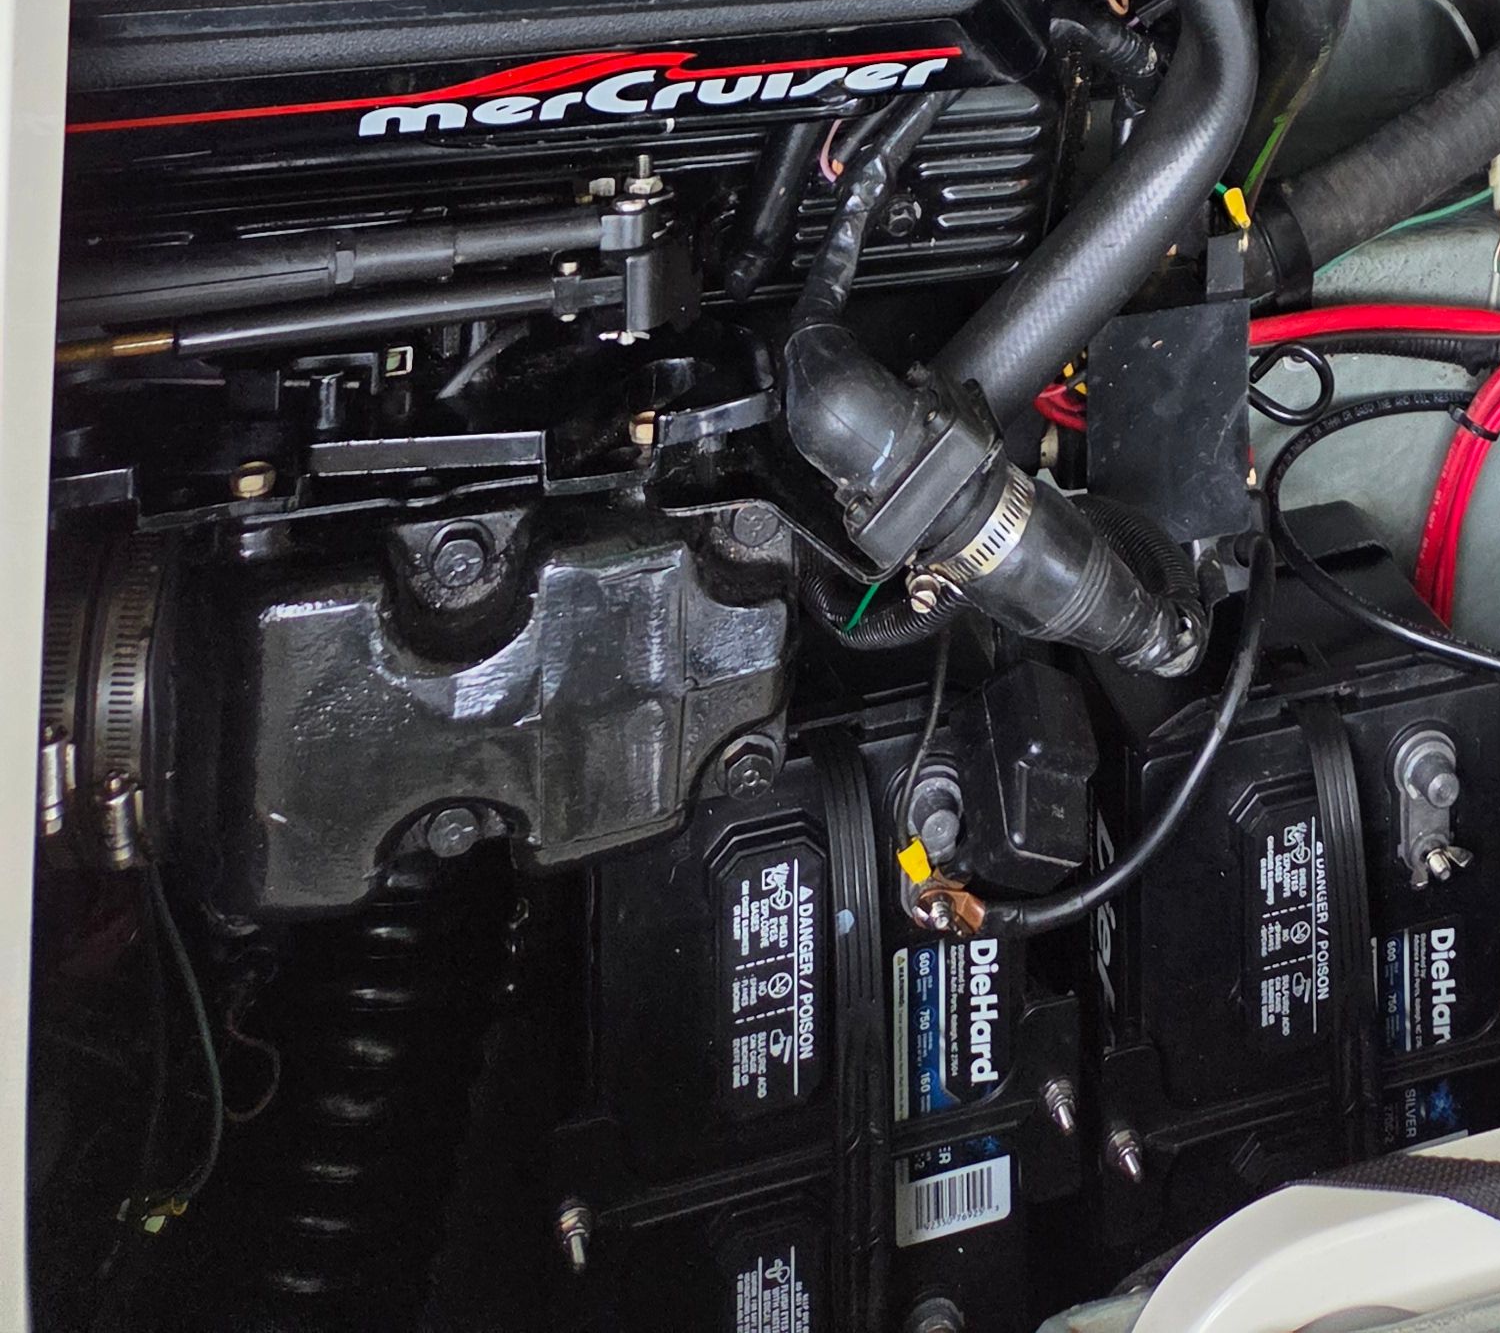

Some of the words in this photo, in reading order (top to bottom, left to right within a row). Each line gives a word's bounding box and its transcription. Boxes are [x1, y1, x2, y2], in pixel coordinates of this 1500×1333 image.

[1316, 858, 1328, 923] DANGER
[750, 901, 760, 932] GASES
[760, 899, 770, 949] EXPLOSIVE
[769, 918, 778, 942] EYES
[778, 915, 788, 948] SHIELD
[799, 903, 813, 975] DANGER
[950, 945, 958, 975] Advance
[1386, 940, 1397, 962] 600
[1413, 934, 1421, 961] Advance
[918, 952, 930, 975] 600
[957, 944, 965, 985] Distributed
[1317, 941, 1329, 1000] POISON
[1413, 962, 1421, 977] Auto
[758, 981, 767, 996] NO
[950, 976, 958, 992] Auto
[1430, 928, 1456, 1045] DieHar
[970, 938, 999, 1083] DieHard
[1387, 993, 1398, 1013] 750
[799, 993, 814, 1059] POISON
[918, 1009, 931, 1030] 750
[757, 1031, 767, 1074] SULFURIC
[950, 1042, 958, 1053] NC
[757, 1077, 767, 1099] ACID
[919, 1071, 931, 1093] 160
[1404, 1088, 1416, 1138] SILVER
[781, 1284, 789, 1310] FLUSH
[781, 1311, 789, 1331] EYES
